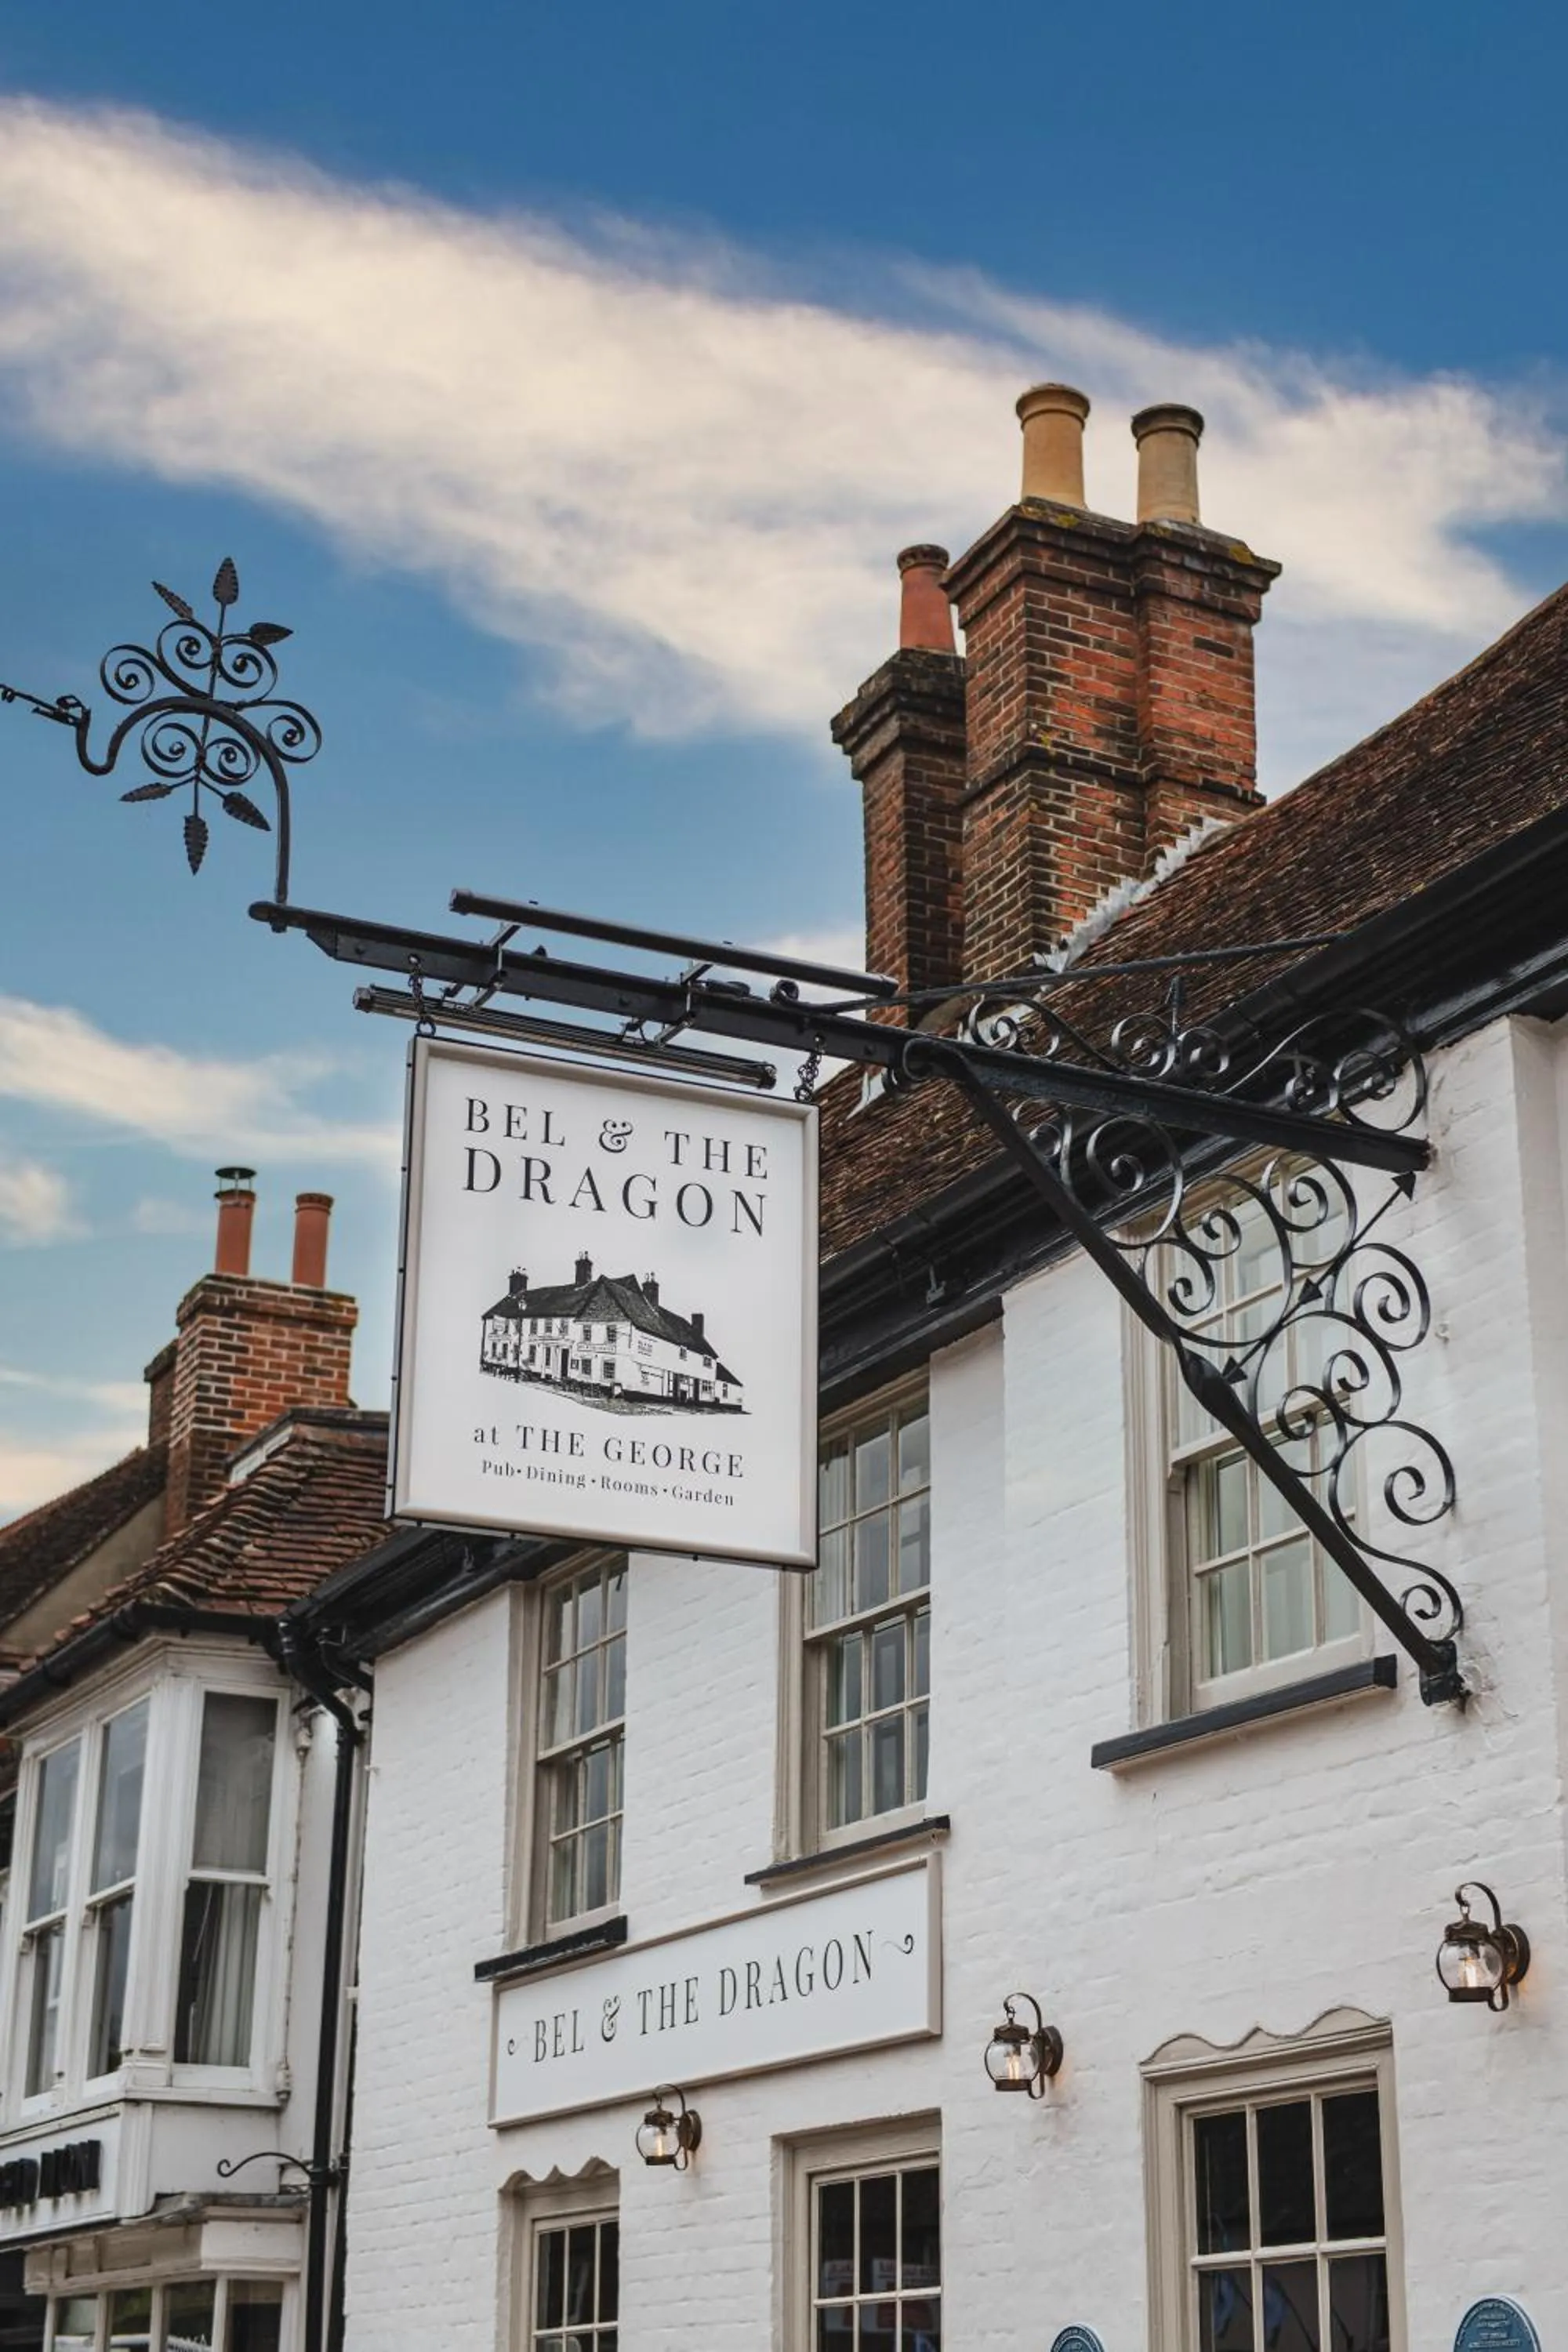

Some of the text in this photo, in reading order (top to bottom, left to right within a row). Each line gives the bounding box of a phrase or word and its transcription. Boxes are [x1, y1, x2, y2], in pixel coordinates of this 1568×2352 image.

[465, 1097, 768, 1180] BEL & THE
[463, 1147, 767, 1236] DRAGON
[474, 1425, 744, 1479] at THE GEORGE
[534, 1929, 874, 2063] BEL & THE DRAGON
